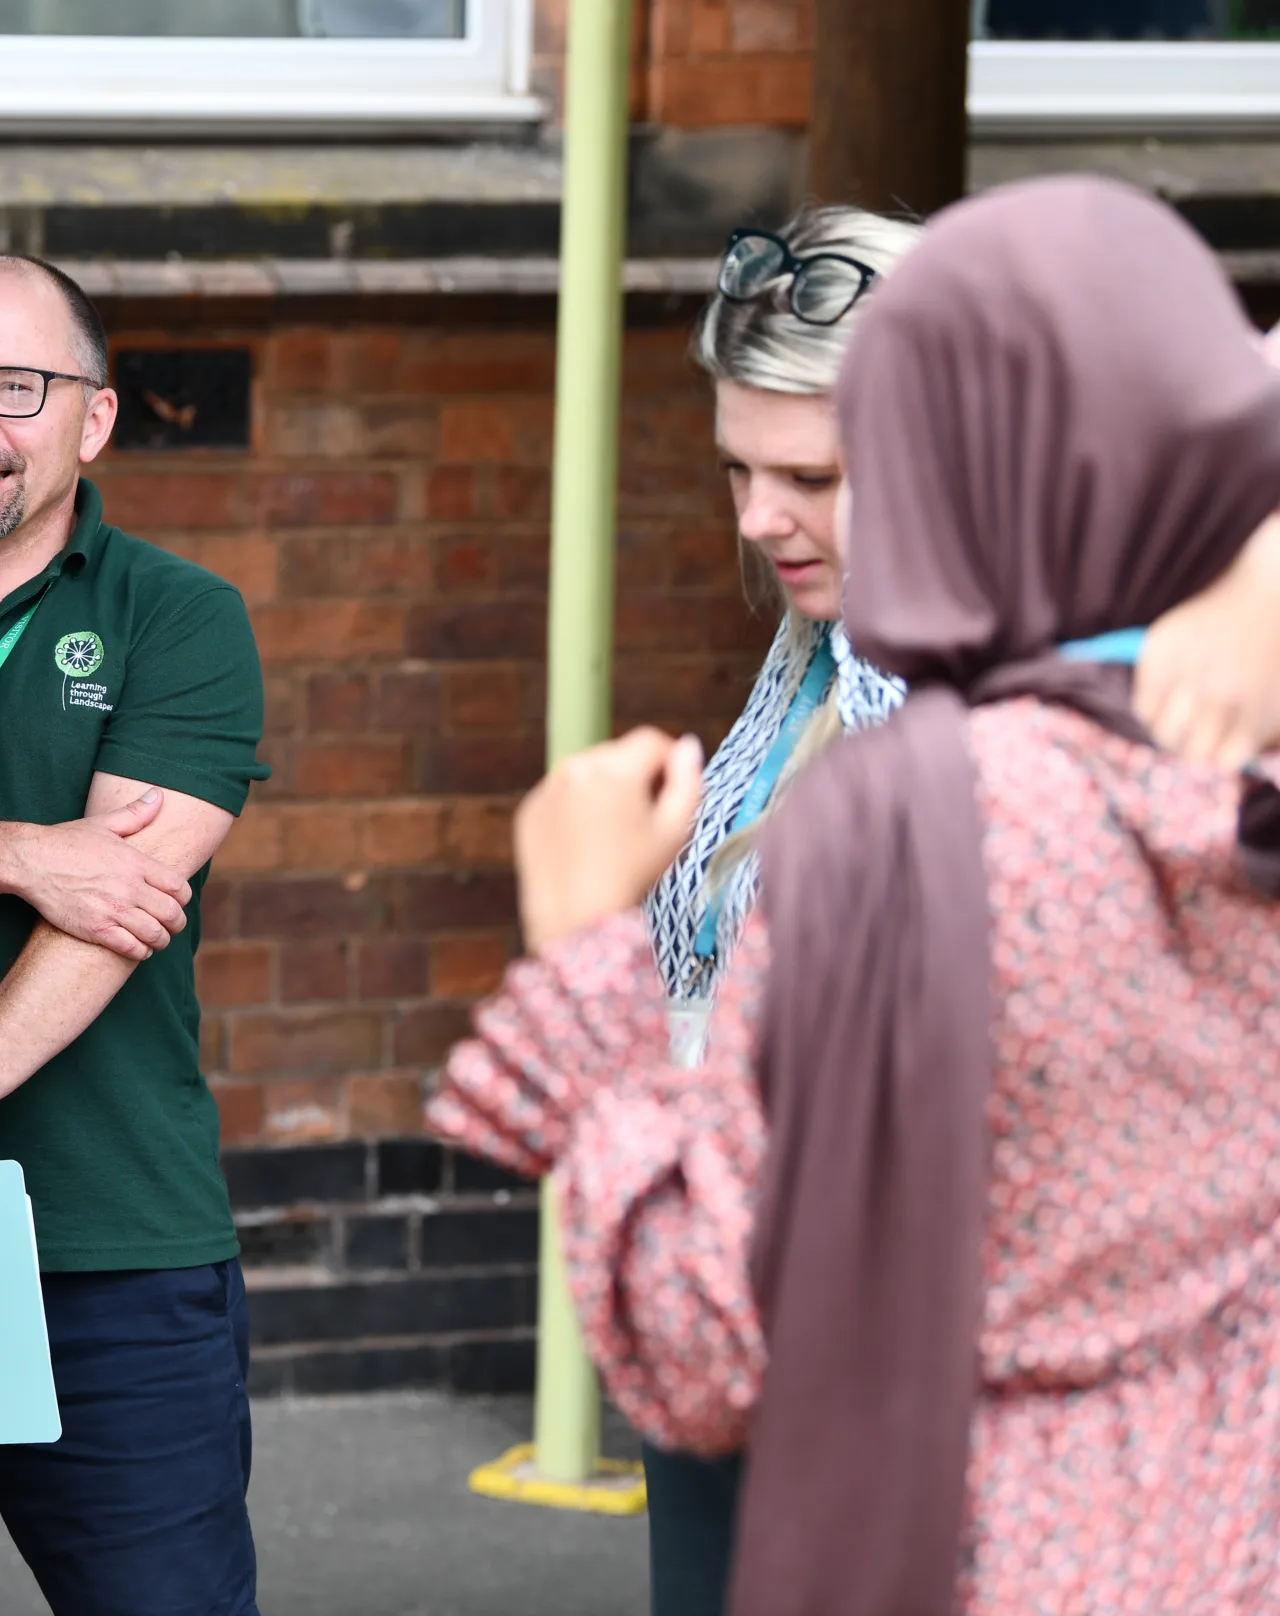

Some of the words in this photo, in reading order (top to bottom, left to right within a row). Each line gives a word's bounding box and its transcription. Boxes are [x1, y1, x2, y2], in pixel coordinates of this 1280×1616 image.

[0, 614, 29, 649] VISITOR
[71, 681, 107, 694] Learning
[70, 689, 103, 701] through
